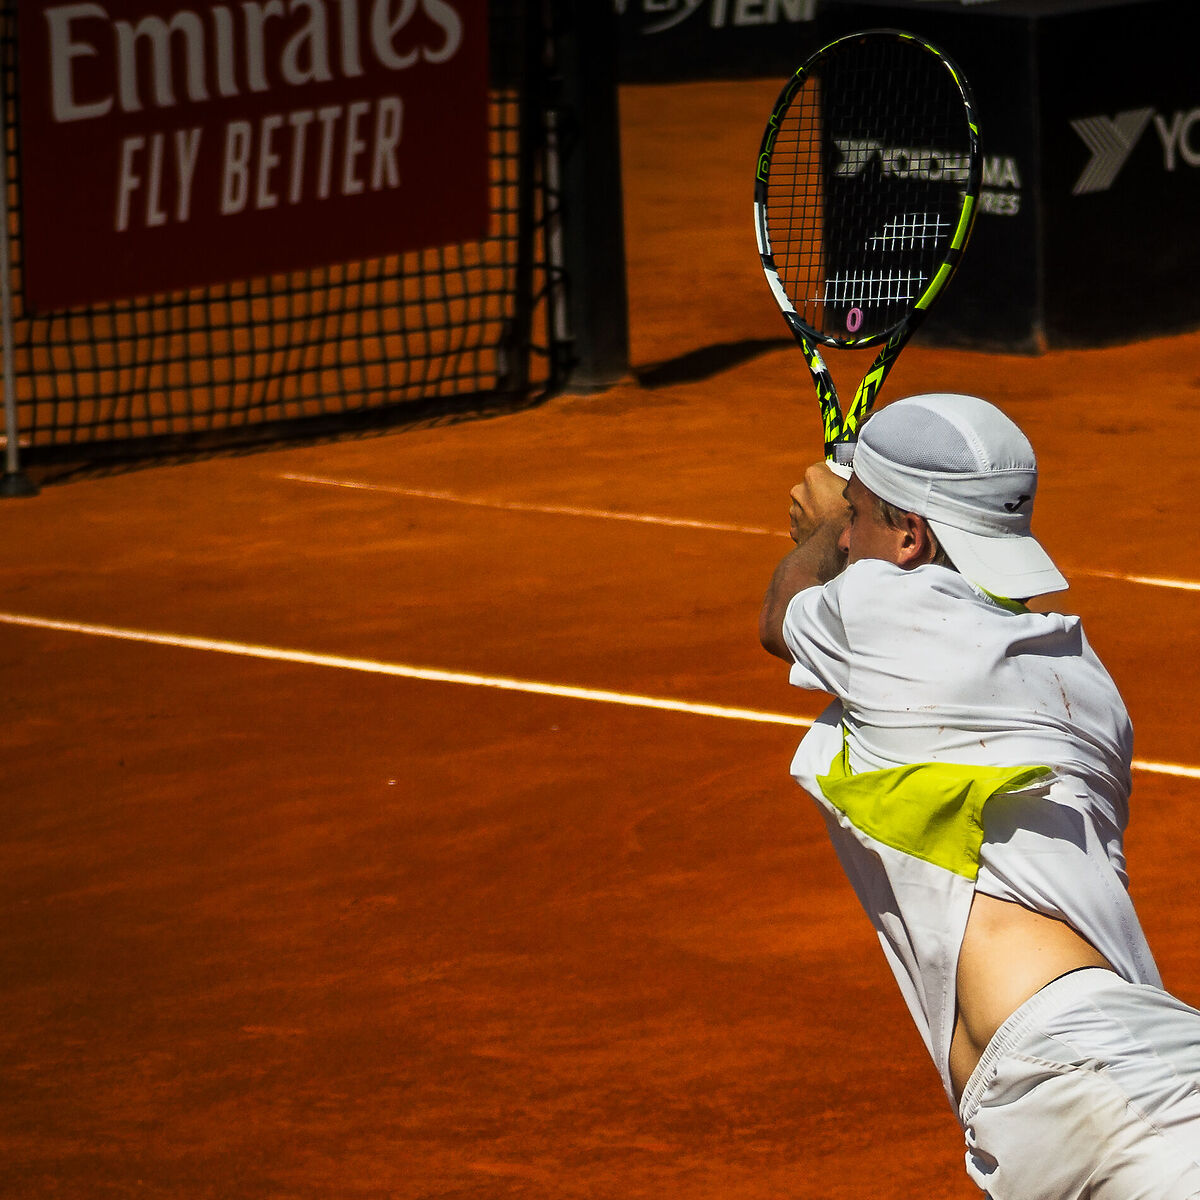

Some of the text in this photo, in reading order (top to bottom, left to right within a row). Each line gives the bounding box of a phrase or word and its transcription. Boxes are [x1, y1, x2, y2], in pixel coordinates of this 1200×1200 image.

[43, 0, 464, 124] Emirates
[114, 95, 404, 233] FLY BETTER
